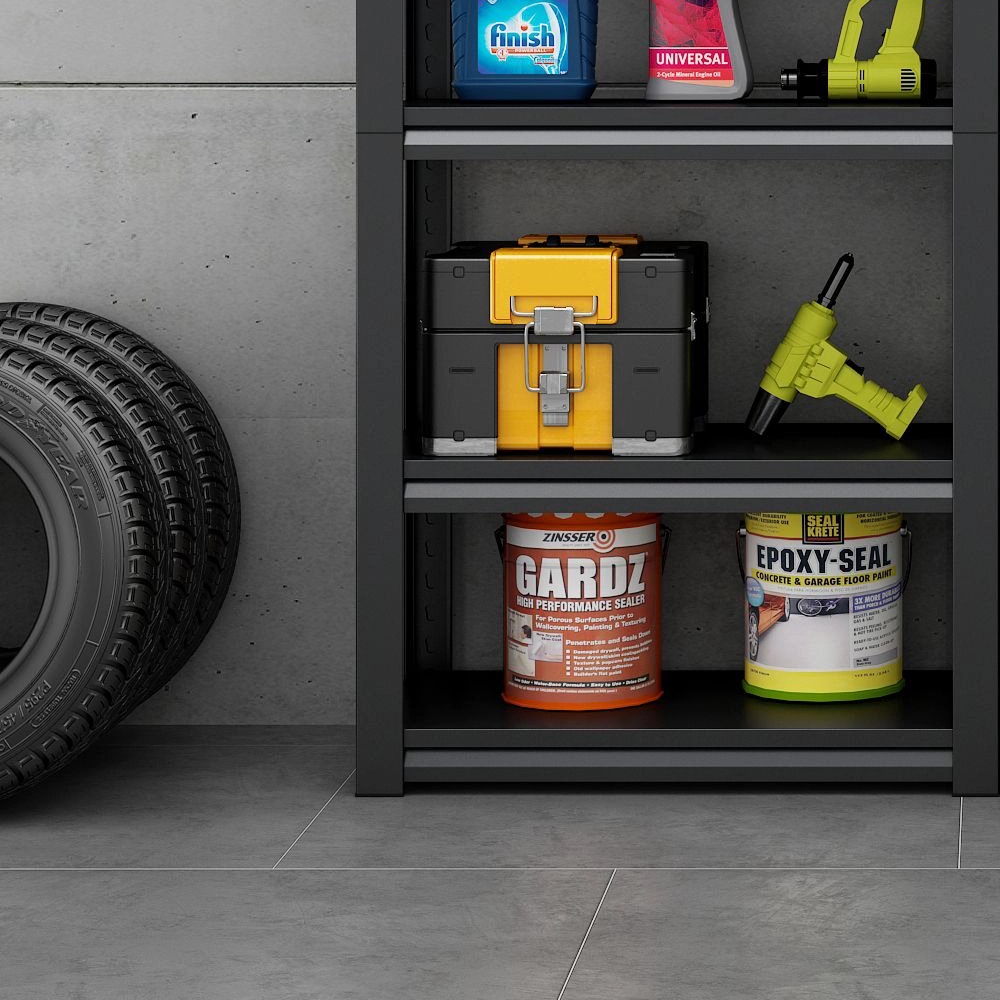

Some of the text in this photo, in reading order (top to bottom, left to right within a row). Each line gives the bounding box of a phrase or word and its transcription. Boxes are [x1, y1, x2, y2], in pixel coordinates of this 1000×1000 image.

[491, 23, 555, 47] finish
[656, 53, 729, 65] UNIVERSAL
[695, 71, 713, 79] Engine
[807, 515, 839, 527] SEAL
[542, 532, 596, 542] ZINSSER
[807, 526, 840, 537] KRETE
[756, 543, 891, 574] EPOXY-SEAL
[516, 552, 646, 599] GARDZ
[755, 568, 892, 586] CONCRETE & GARAGE FLOOR PAINT
[516, 594, 645, 612] HIGH PERFORMANCE SEALER
[864, 594, 881, 604] MORE
[535, 614, 546, 622] For
[575, 616, 608, 624] Surfaces
[609, 614, 626, 622] Prior
[535, 622, 581, 632] Wallcovering,
[622, 617, 647, 627] Texturing
[566, 639, 606, 647] Penetrates
[608, 637, 621, 645] and
[621, 634, 638, 643] Seals
